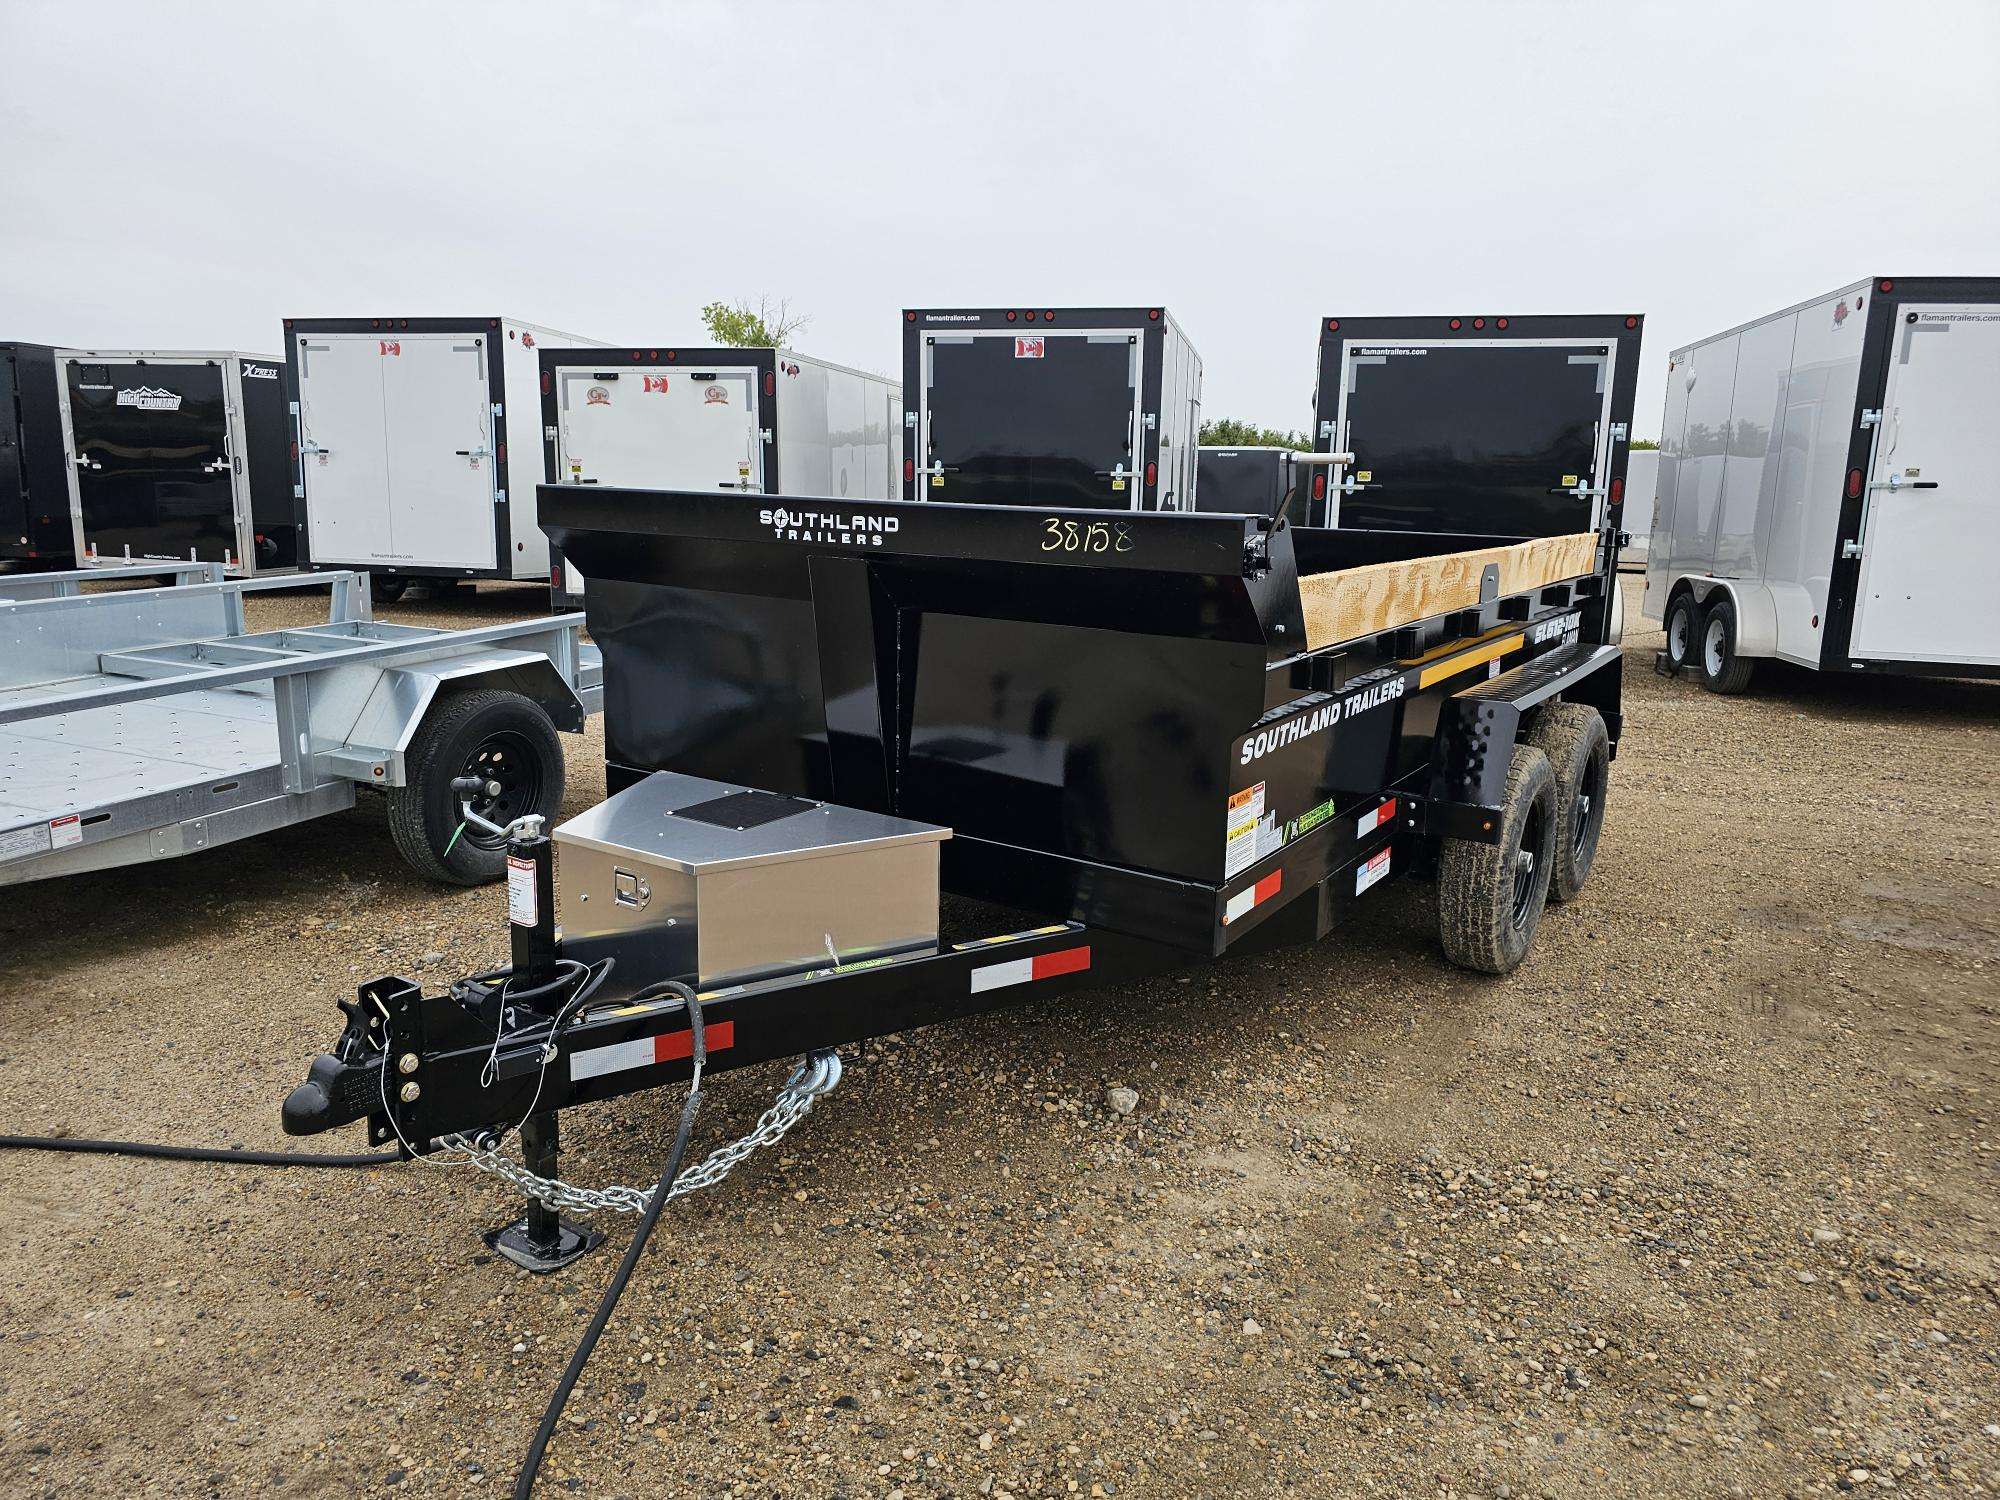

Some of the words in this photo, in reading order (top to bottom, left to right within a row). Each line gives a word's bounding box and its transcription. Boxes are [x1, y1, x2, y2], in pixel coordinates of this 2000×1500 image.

[1361, 348, 1427, 356] flamantrailers.com
[119, 392, 140, 404] HIGH
[139, 397, 179, 409] COUNTRY
[759, 507, 899, 533] SOUTHLAND
[774, 528, 883, 546] TRAILERS
[1040, 518, 1135, 552] 38158
[1240, 702, 1342, 765] SOUTHLAND
[1344, 676, 1405, 719] TRAILERS
